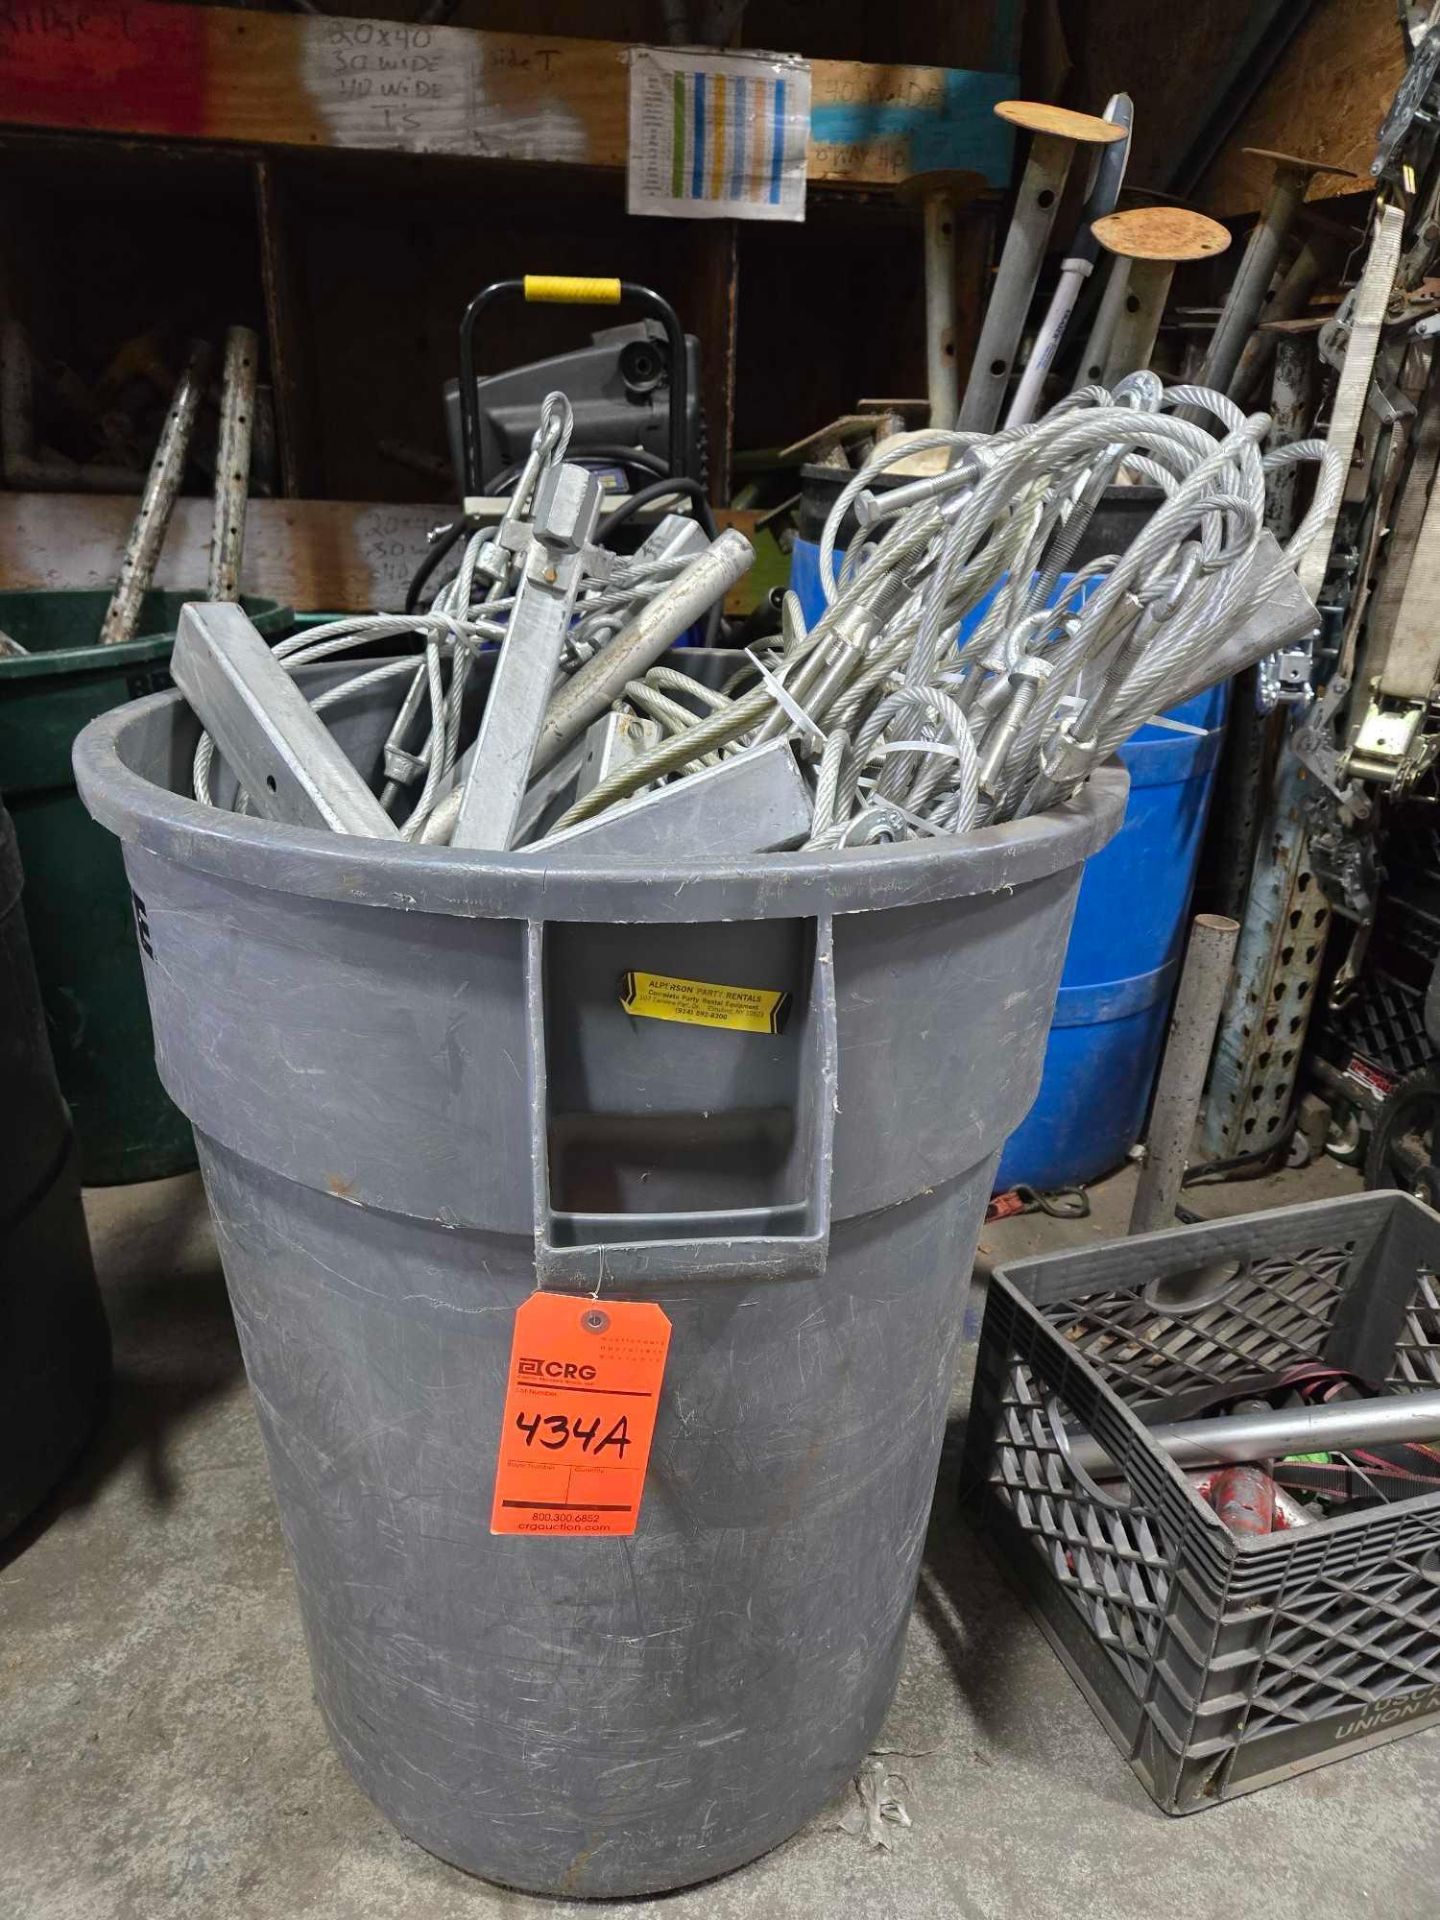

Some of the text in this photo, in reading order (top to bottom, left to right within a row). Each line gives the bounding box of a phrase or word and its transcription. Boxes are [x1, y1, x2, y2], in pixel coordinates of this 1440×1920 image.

[648, 981, 762, 1003] ALPERSON PARTY RENTALS
[545, 1360, 598, 1381] CRG
[516, 1410, 632, 1460] 434A
[518, 1522, 612, 1532] crgauction.com
[532, 1512, 600, 1523] 800.300.6852
[1335, 1702, 1421, 1739] UNION
